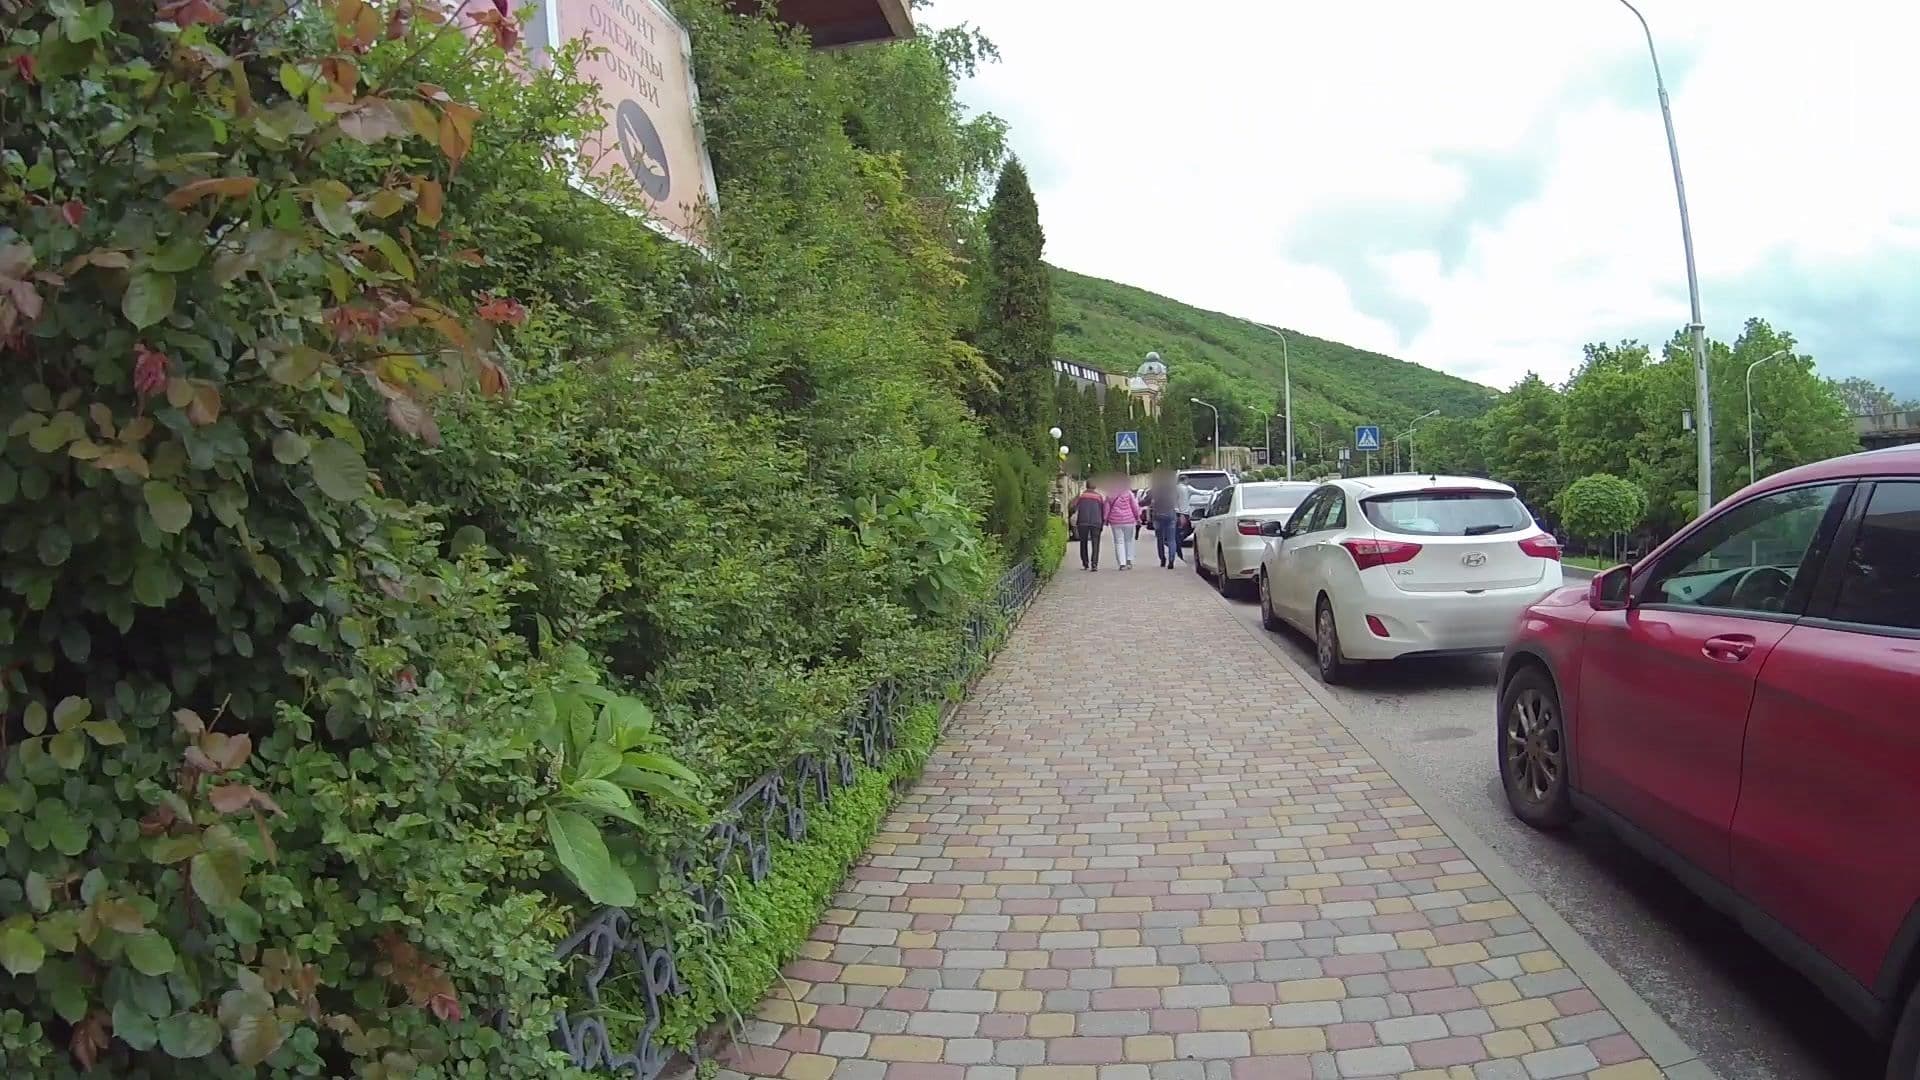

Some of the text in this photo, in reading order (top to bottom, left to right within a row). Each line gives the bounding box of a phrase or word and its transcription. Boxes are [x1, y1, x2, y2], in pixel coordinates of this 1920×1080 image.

[590, 4, 664, 82] ОДЕЖДЫ
[608, 0, 656, 45] МОНТ
[604, 50, 660, 108] ОБУВИ
